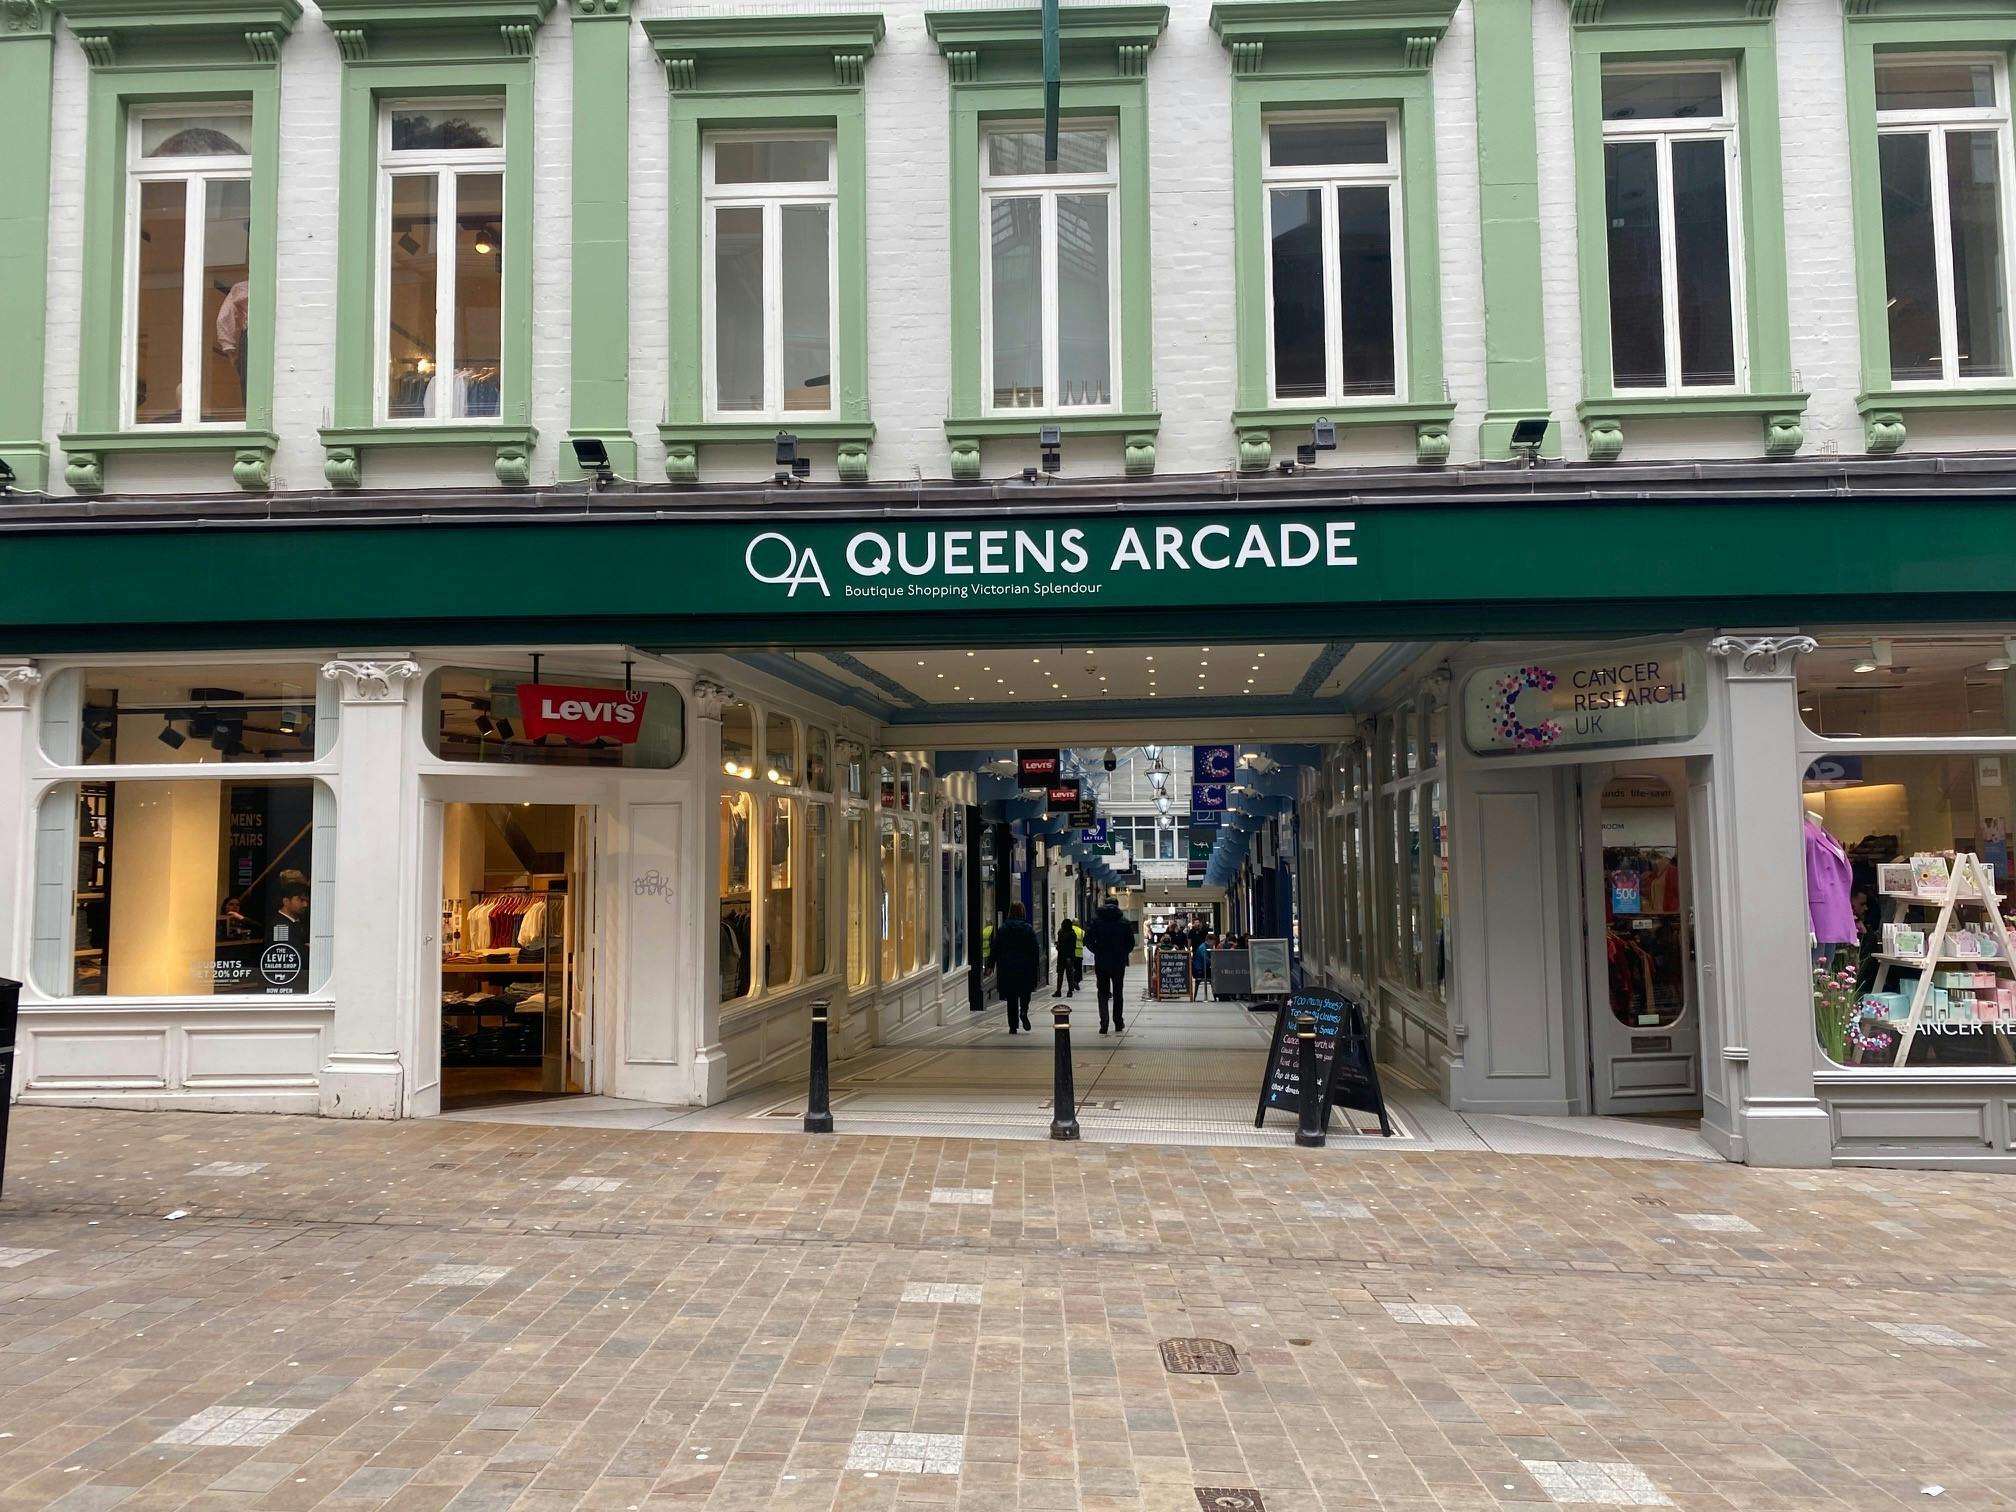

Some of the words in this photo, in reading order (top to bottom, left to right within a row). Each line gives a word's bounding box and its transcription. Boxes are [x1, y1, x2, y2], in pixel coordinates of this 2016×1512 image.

[846, 528, 1089, 576] QUEENS
[1110, 522, 1358, 571] ARCADE
[845, 585, 904, 598] Boutique
[908, 584, 968, 598] Shopping
[971, 583, 1030, 595] Victorian
[1033, 582, 1102, 597] Splendour
[1573, 662, 1660, 689] CANCER
[1574, 683, 1686, 712] RESEARCH
[1576, 715, 1603, 735] UK
[193, 960, 242, 969] UDENTS
[266, 953, 294, 963] LEVI'S
[212, 970, 230, 978] 20%
[232, 969, 252, 978] OFF
[1283, 1034, 1300, 1046] Cance
